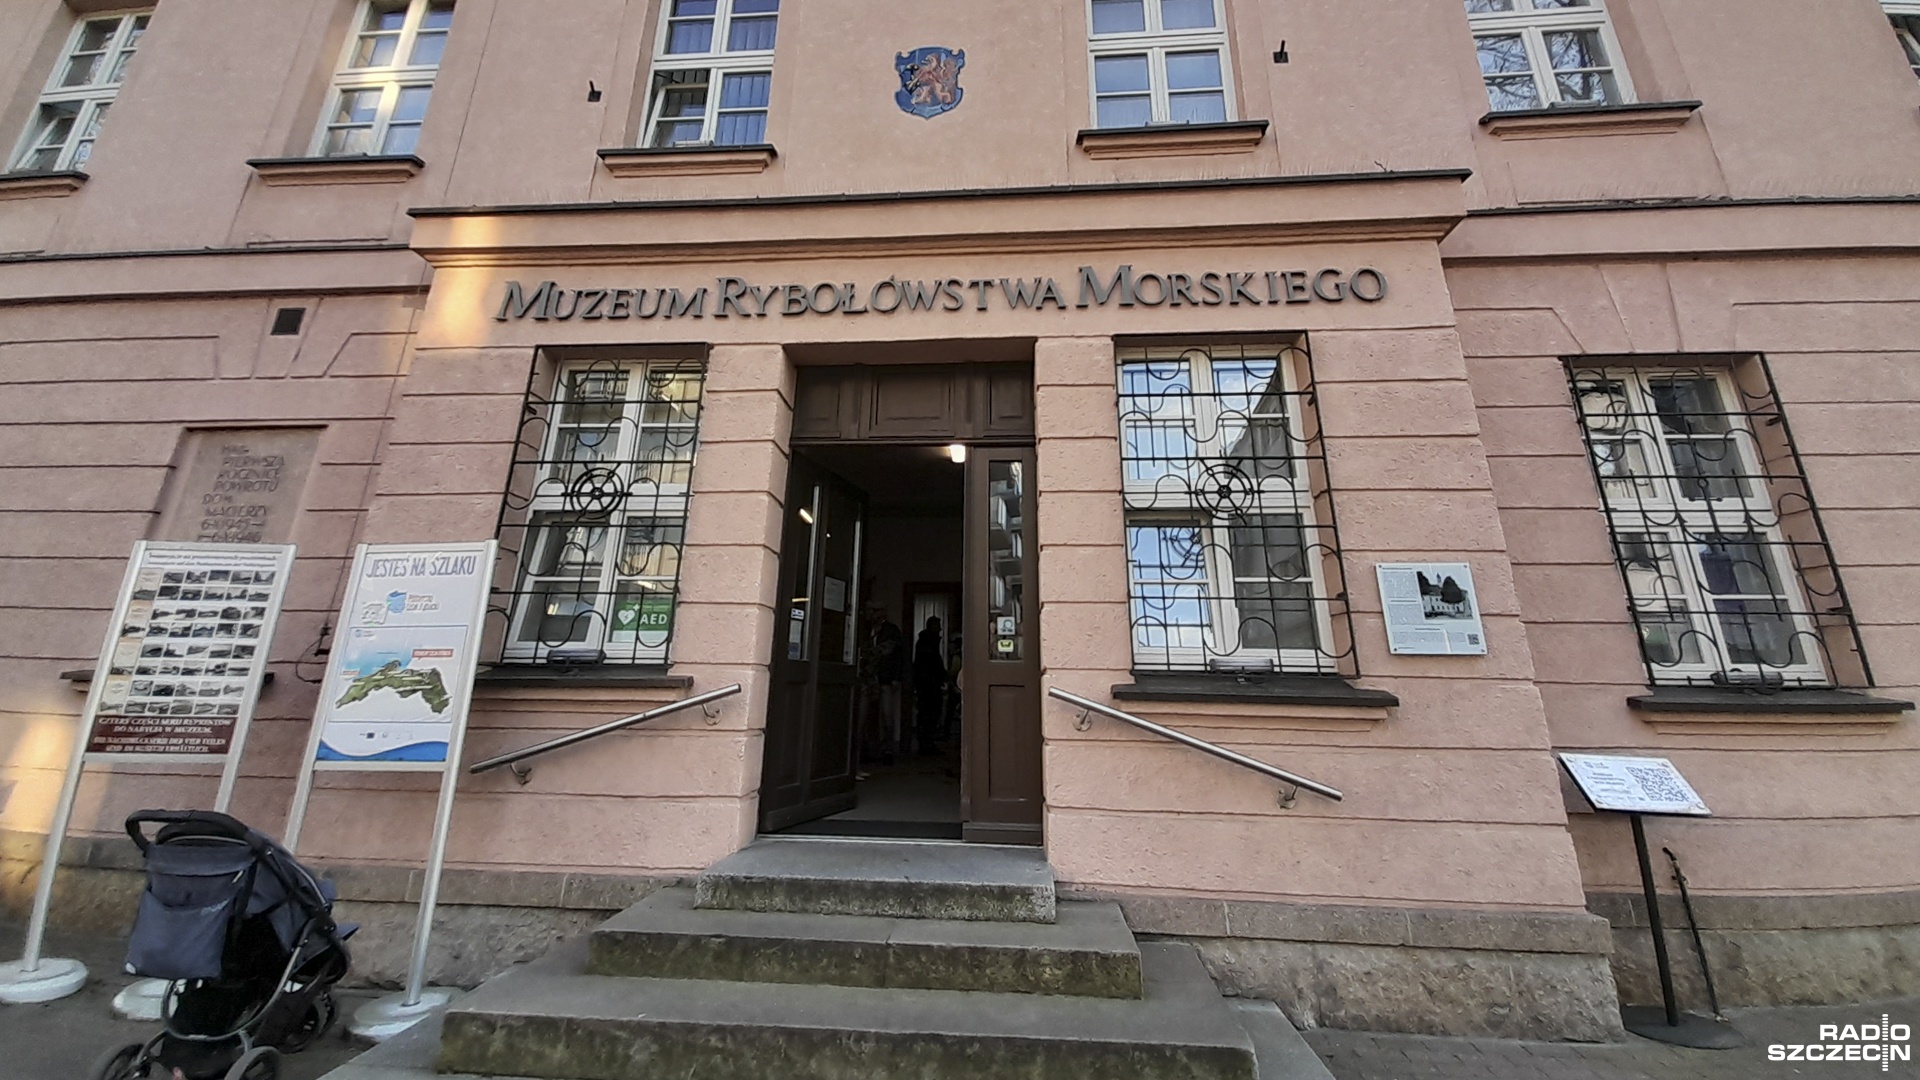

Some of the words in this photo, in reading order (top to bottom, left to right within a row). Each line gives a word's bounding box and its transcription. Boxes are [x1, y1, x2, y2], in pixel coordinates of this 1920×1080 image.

[496, 281, 707, 320] MUZEUM
[713, 276, 1067, 318] RYBOŁÓWSTWA
[1076, 264, 1388, 309] MORSKIEGO
[410, 557, 427, 576] NA
[639, 613, 668, 625] AED
